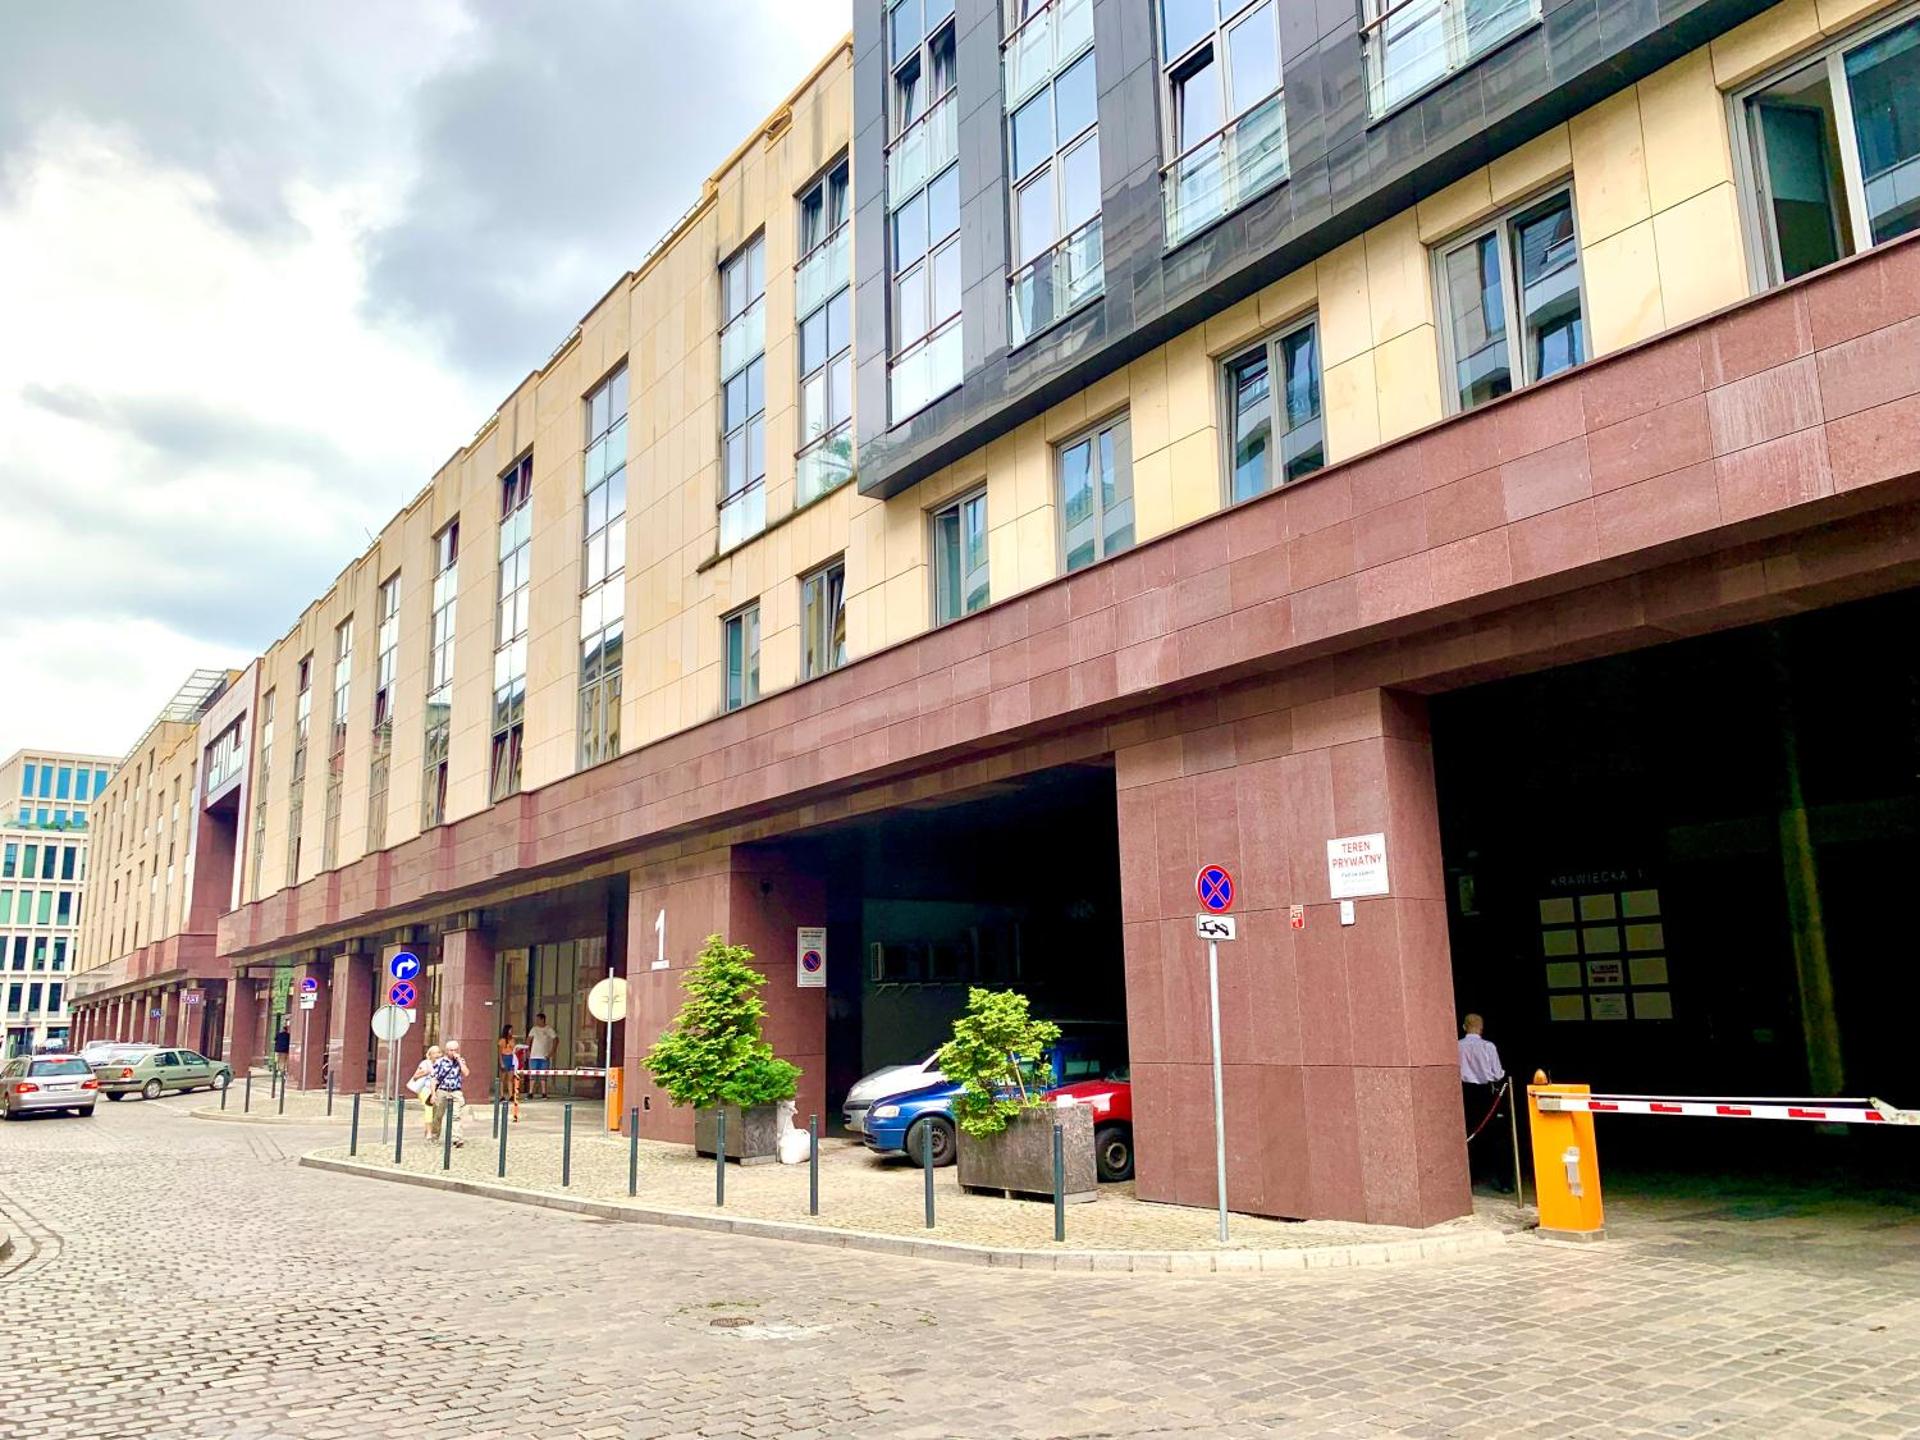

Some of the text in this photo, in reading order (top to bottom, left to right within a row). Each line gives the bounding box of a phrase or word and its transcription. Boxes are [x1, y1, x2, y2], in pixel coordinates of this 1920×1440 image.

[1342, 841, 1370, 853] TEREN
[1332, 853, 1382, 869] PRYWATNY
[654, 909, 666, 963] 1
